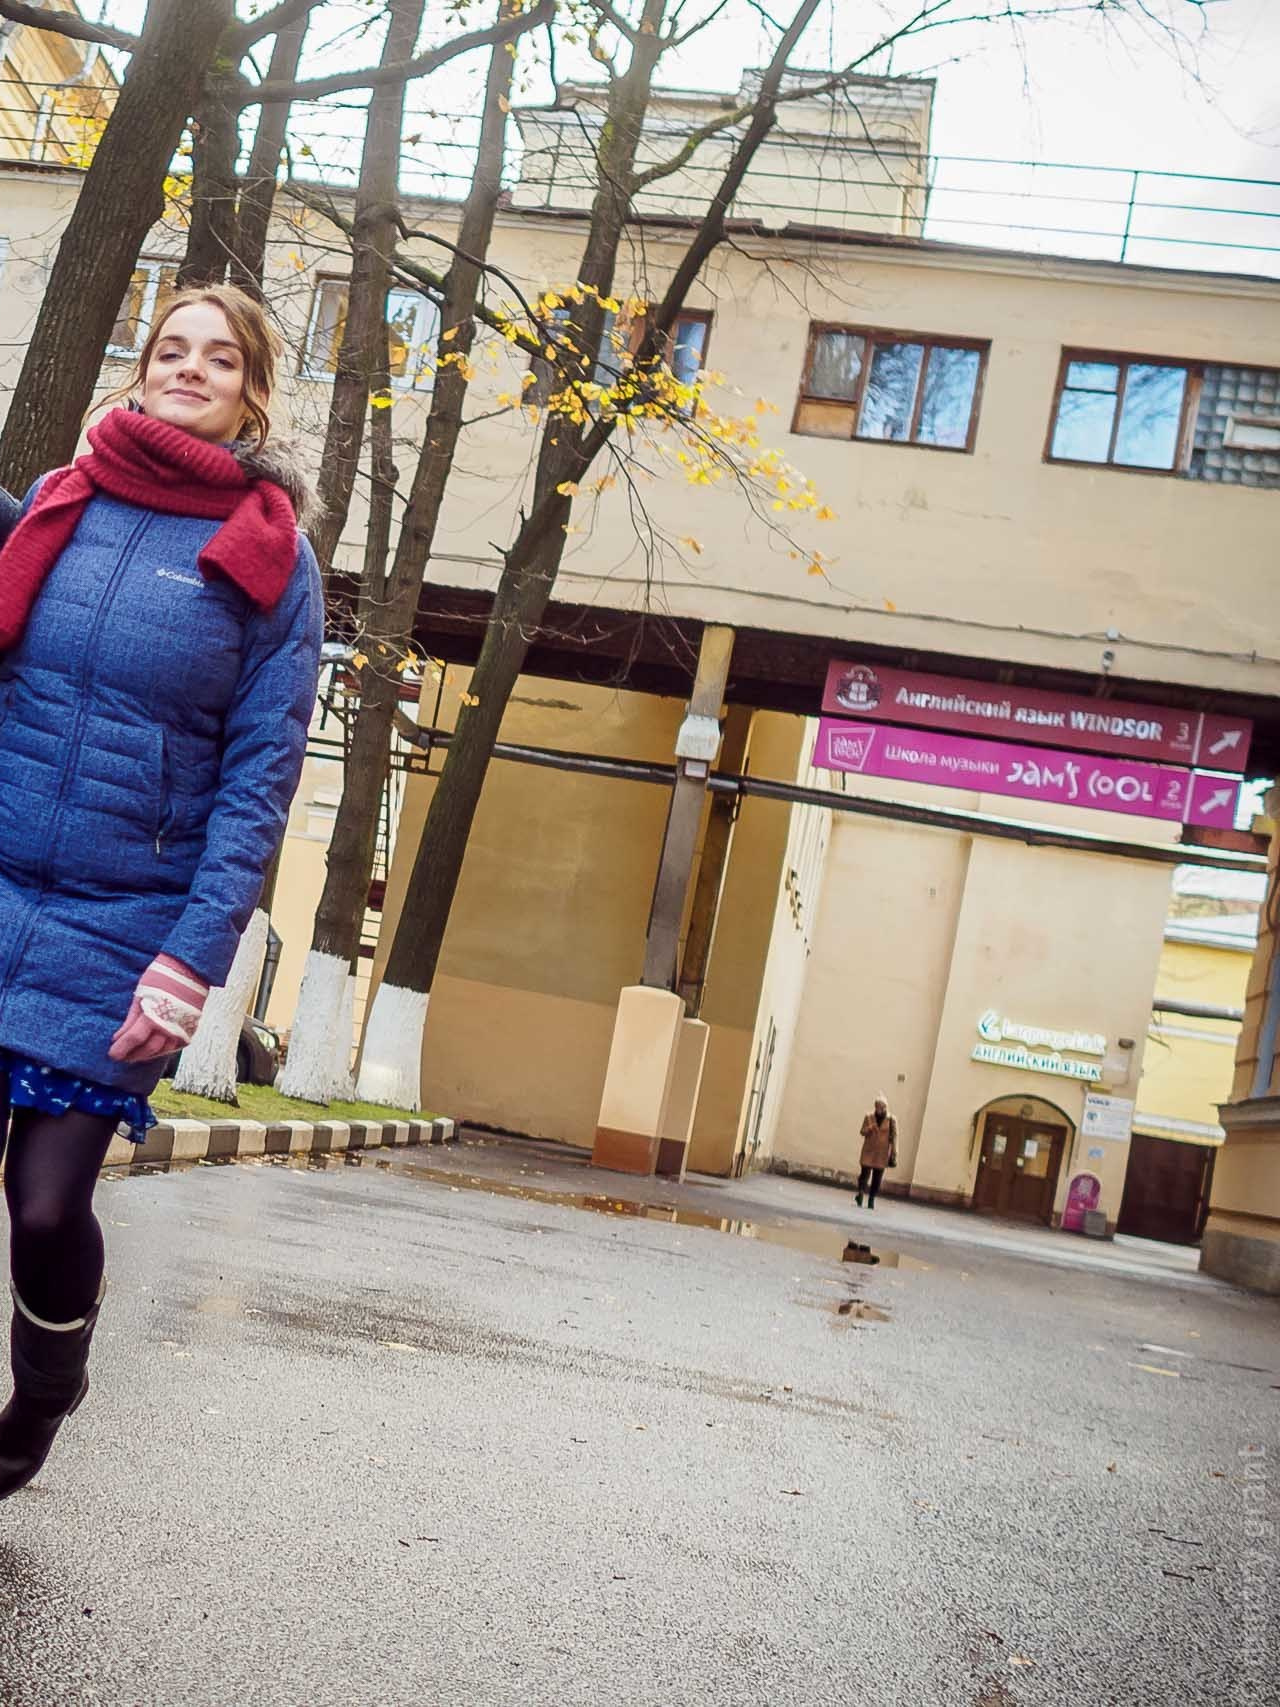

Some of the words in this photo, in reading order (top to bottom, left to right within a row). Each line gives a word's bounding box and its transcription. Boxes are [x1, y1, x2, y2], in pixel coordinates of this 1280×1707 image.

[895, 686, 1011, 720] Английский
[1014, 707, 1065, 727] язык
[1071, 711, 1163, 741] WINDSOR
[884, 744, 937, 766] Школа
[940, 755, 1000, 775] музыки
